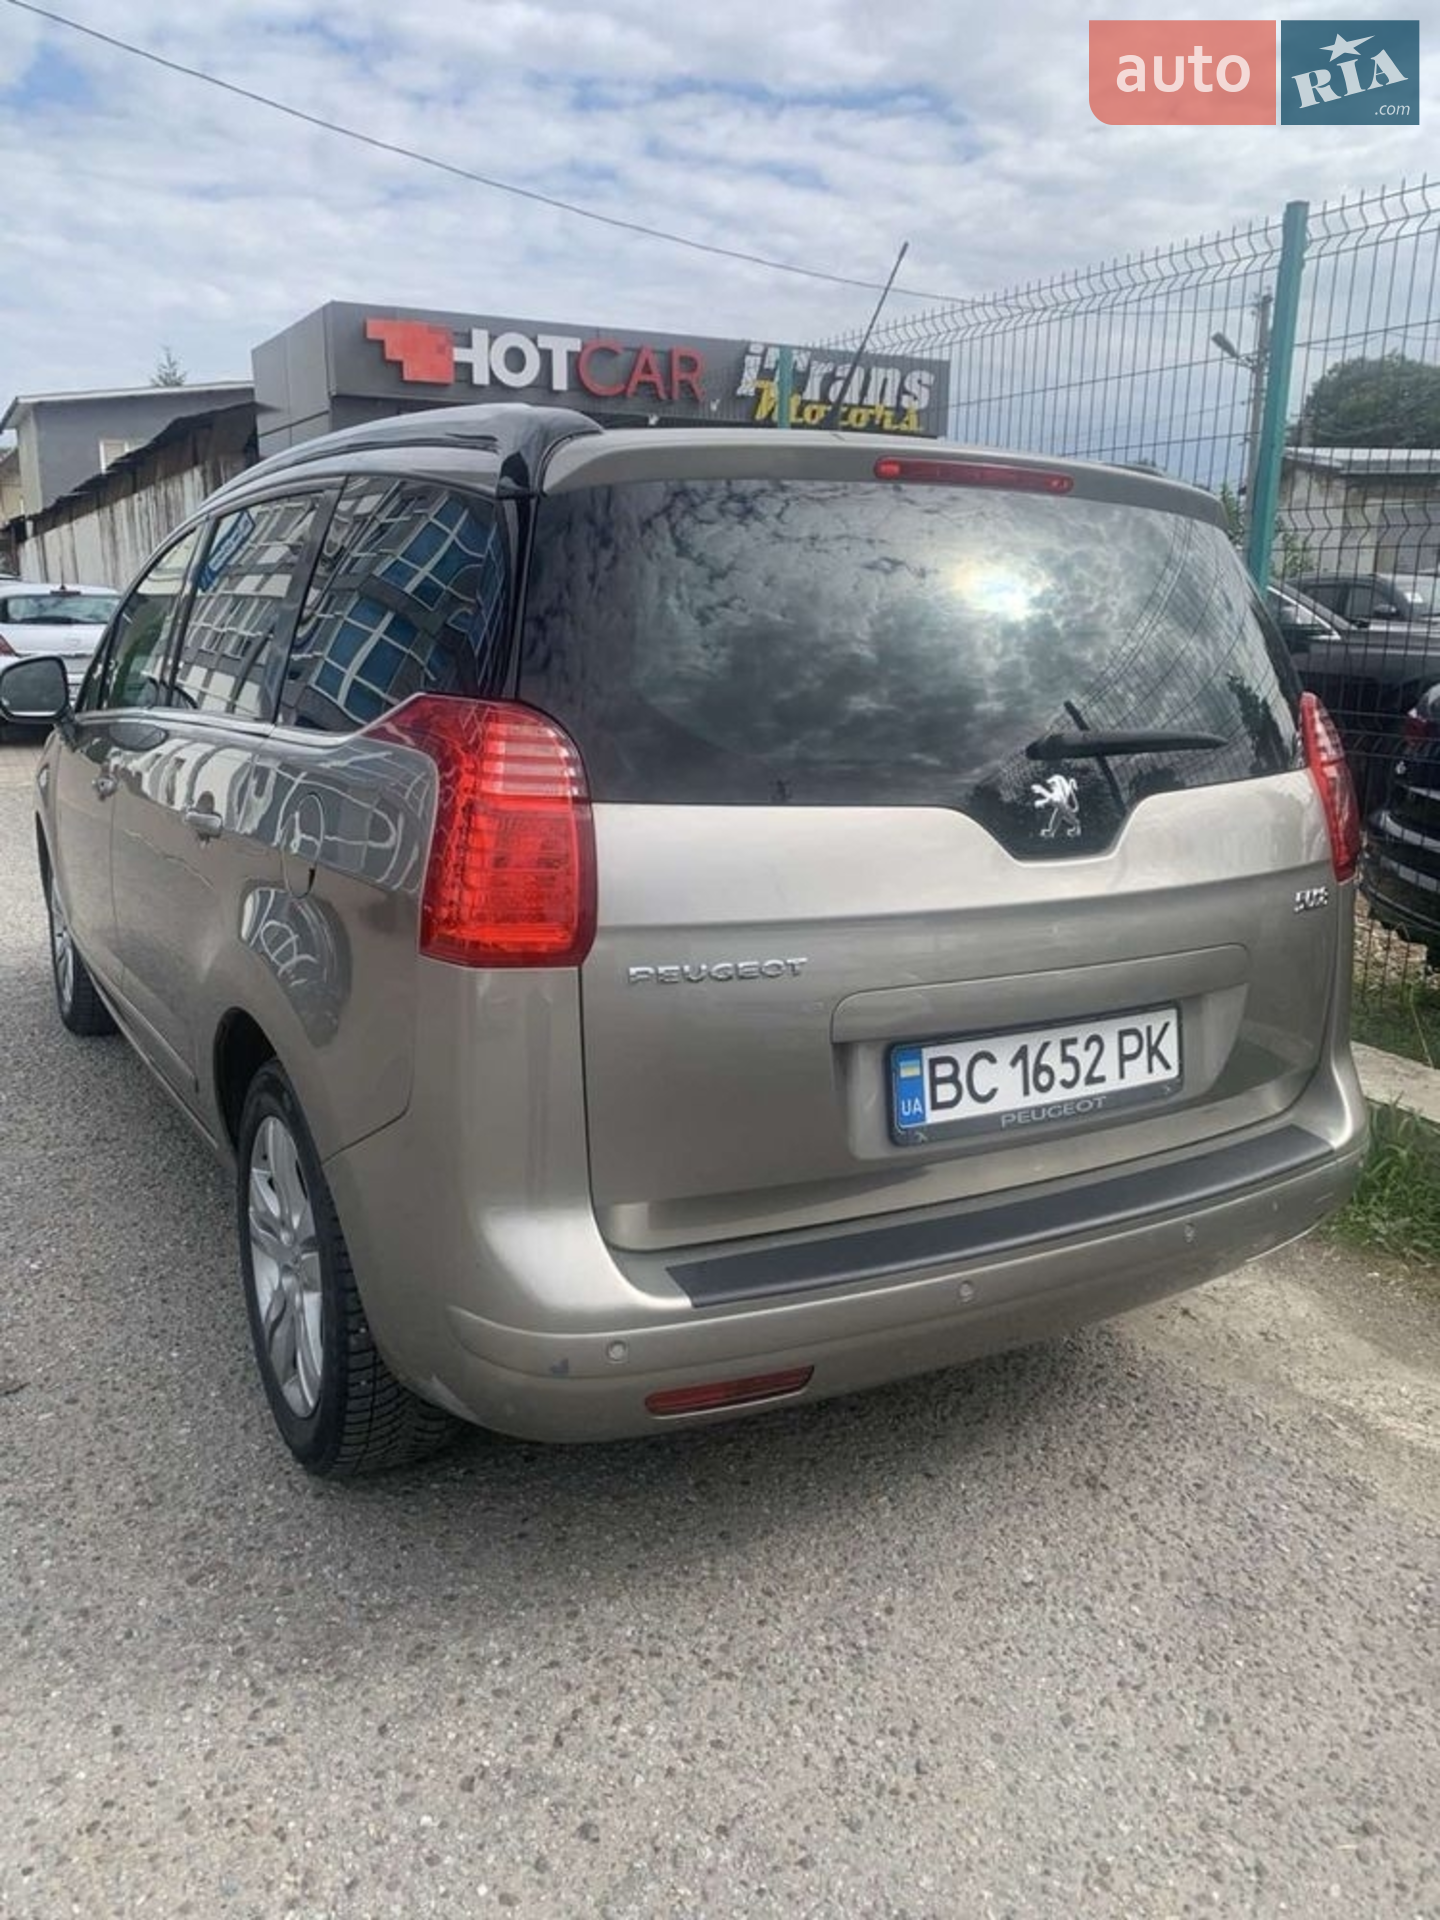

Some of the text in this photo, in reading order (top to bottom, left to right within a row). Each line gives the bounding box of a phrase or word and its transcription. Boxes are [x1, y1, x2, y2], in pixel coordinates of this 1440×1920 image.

[628, 957, 808, 985] PEUGEOT
[928, 1021, 1172, 1111] BC 1652 PK
[901, 1098, 923, 1117] UA
[1001, 1095, 1107, 1129] PEUGEOT
